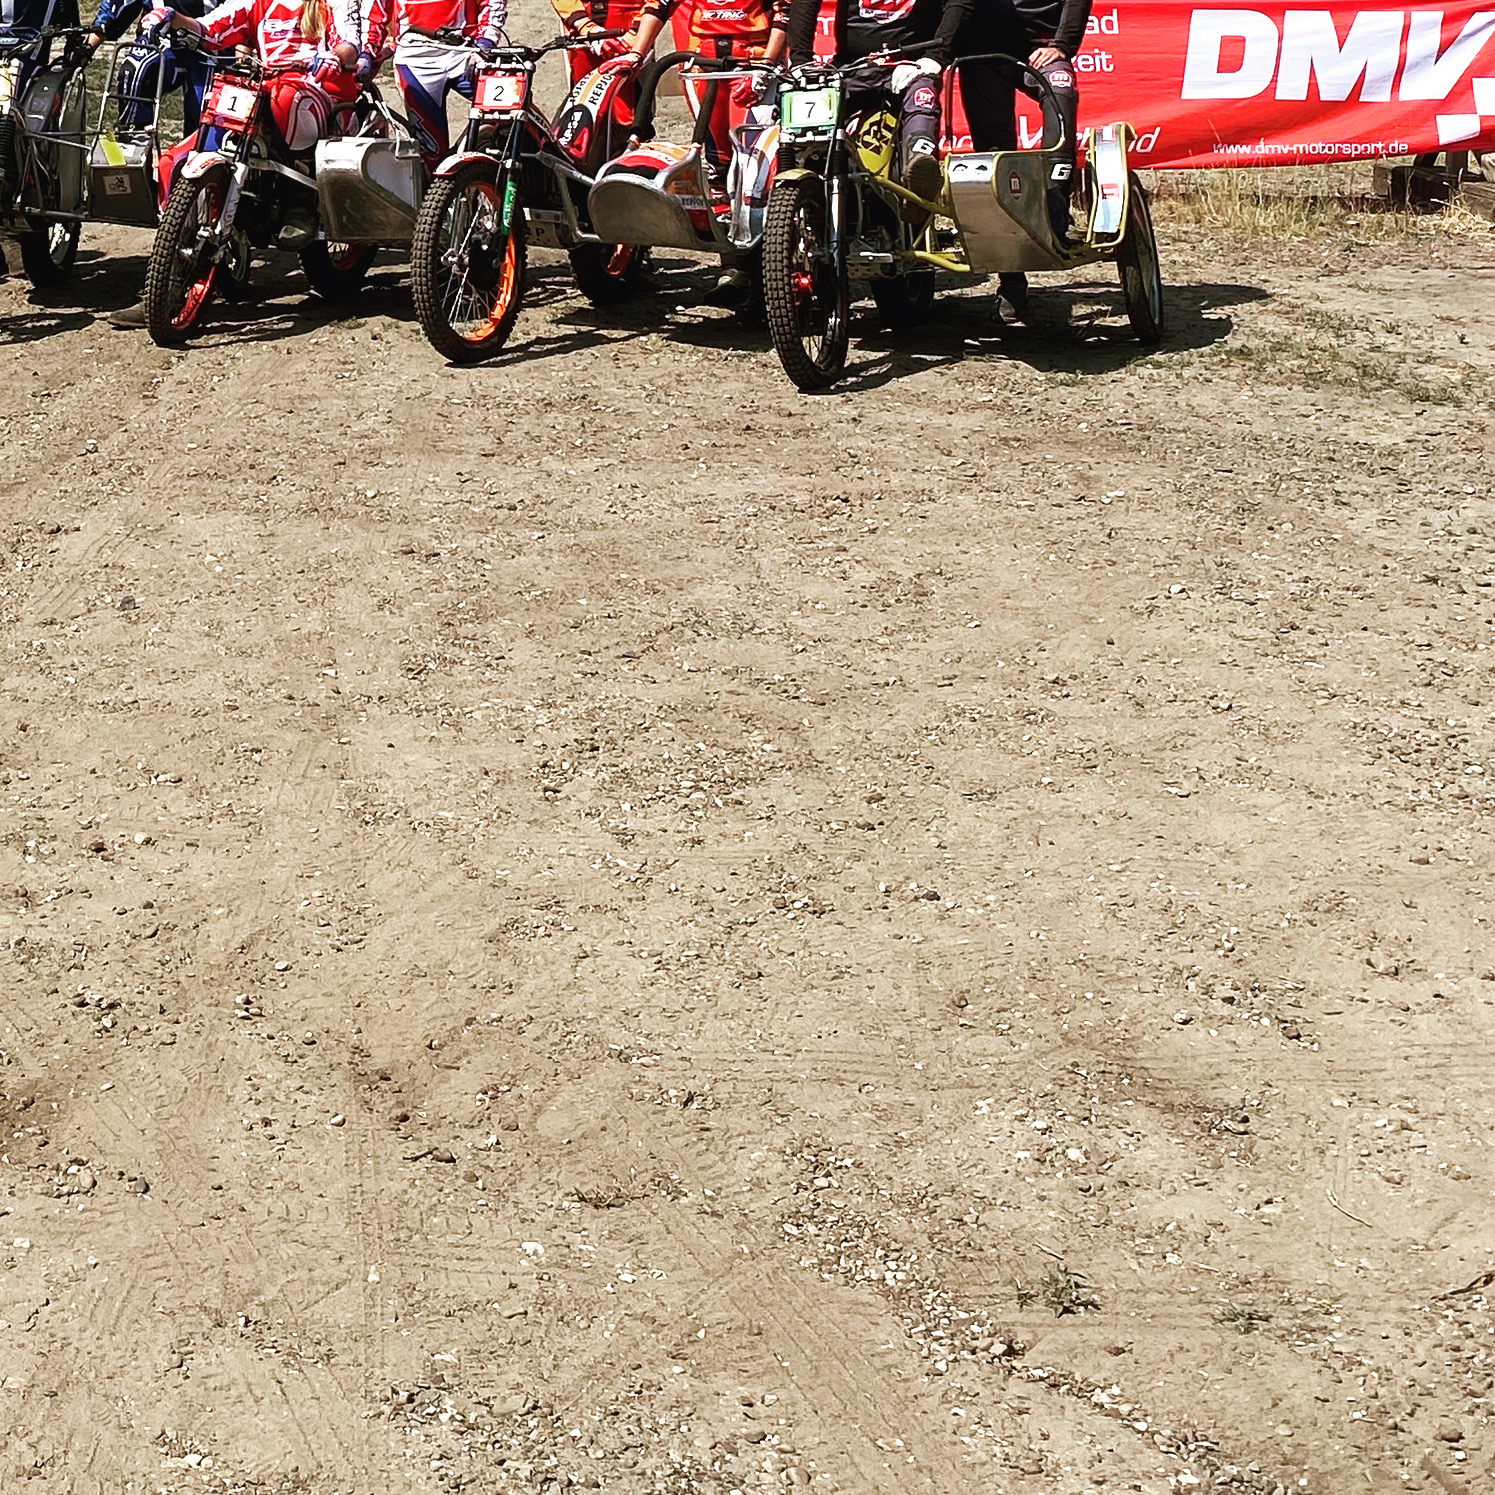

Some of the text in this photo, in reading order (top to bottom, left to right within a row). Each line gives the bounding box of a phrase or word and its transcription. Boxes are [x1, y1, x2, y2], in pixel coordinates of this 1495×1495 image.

[1180, 8, 1495, 102] DMV
[493, 85, 503, 101] 2
[588, 72, 613, 106] REPSO
[228, 96, 238, 111] 1
[805, 102, 816, 118] 7
[1213, 140, 1409, 157] www.dmv-motorsport.de
